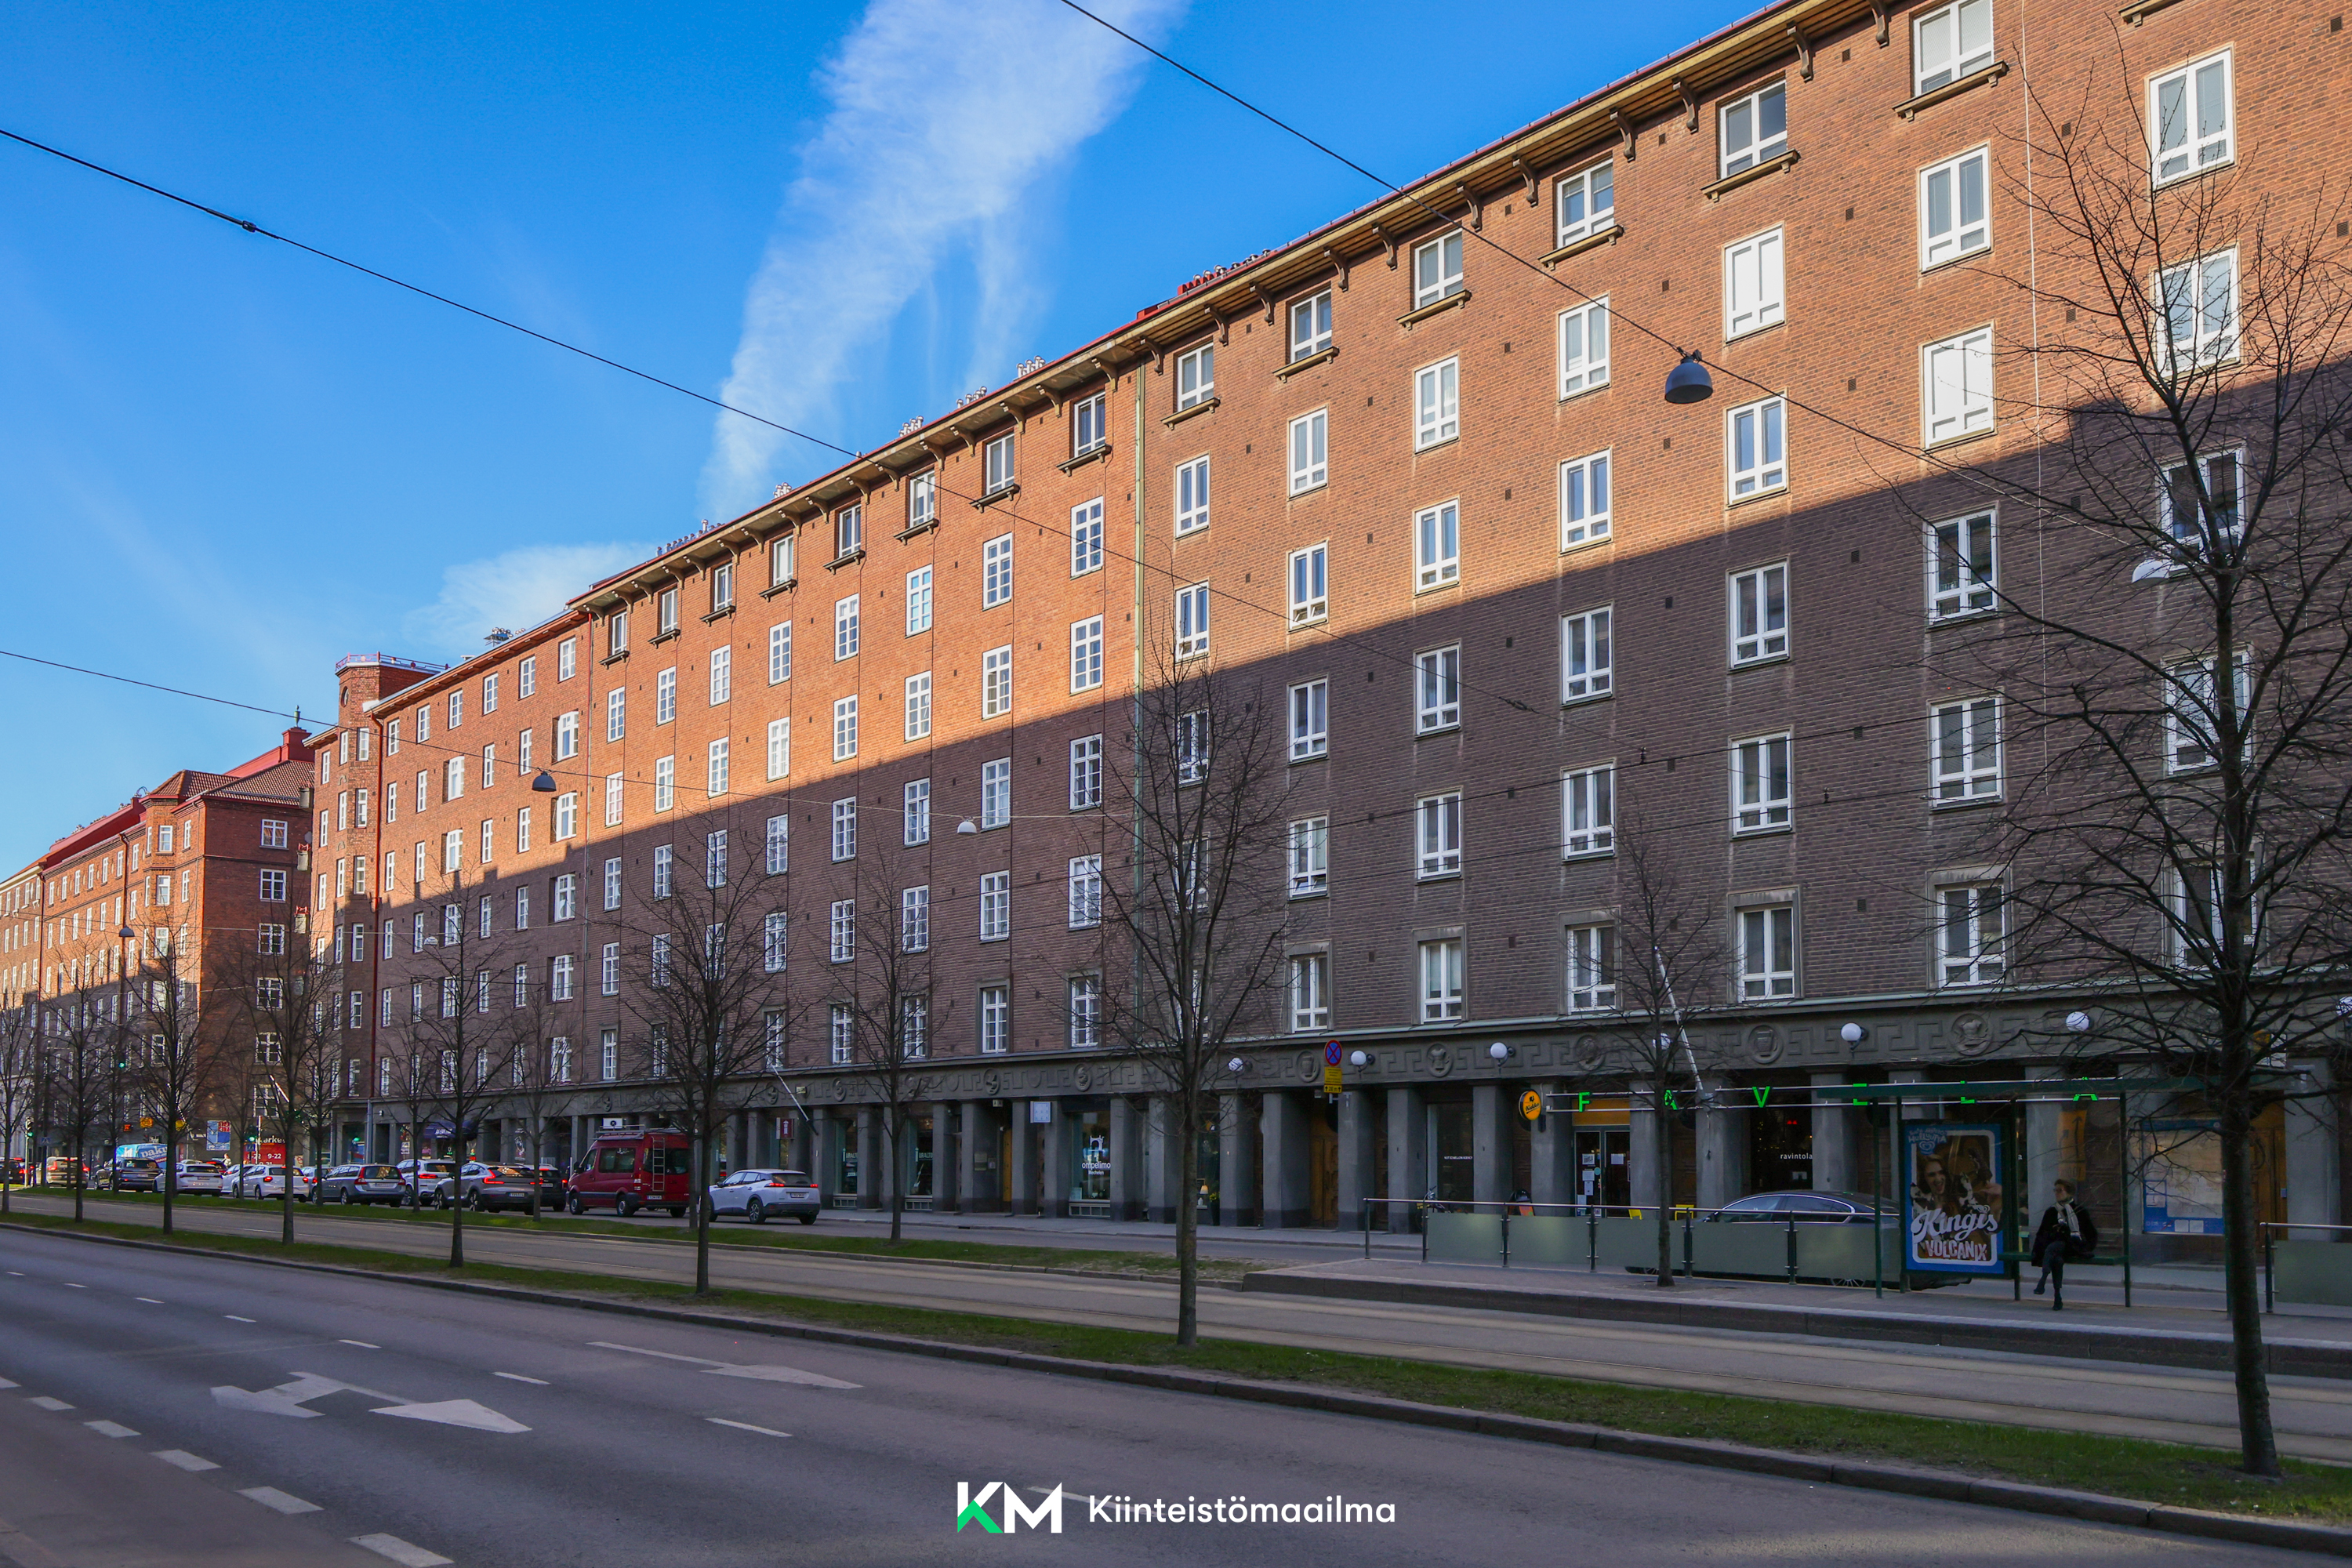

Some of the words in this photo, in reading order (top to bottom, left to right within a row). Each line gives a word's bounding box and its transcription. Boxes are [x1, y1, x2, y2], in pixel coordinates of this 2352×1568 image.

[260, 1134, 286, 1144] arke
[1082, 1162, 1111, 1171] ompelimo
[1911, 1208, 1998, 1244] Kingis
[1925, 1240, 1987, 1261] VOLCANIX
